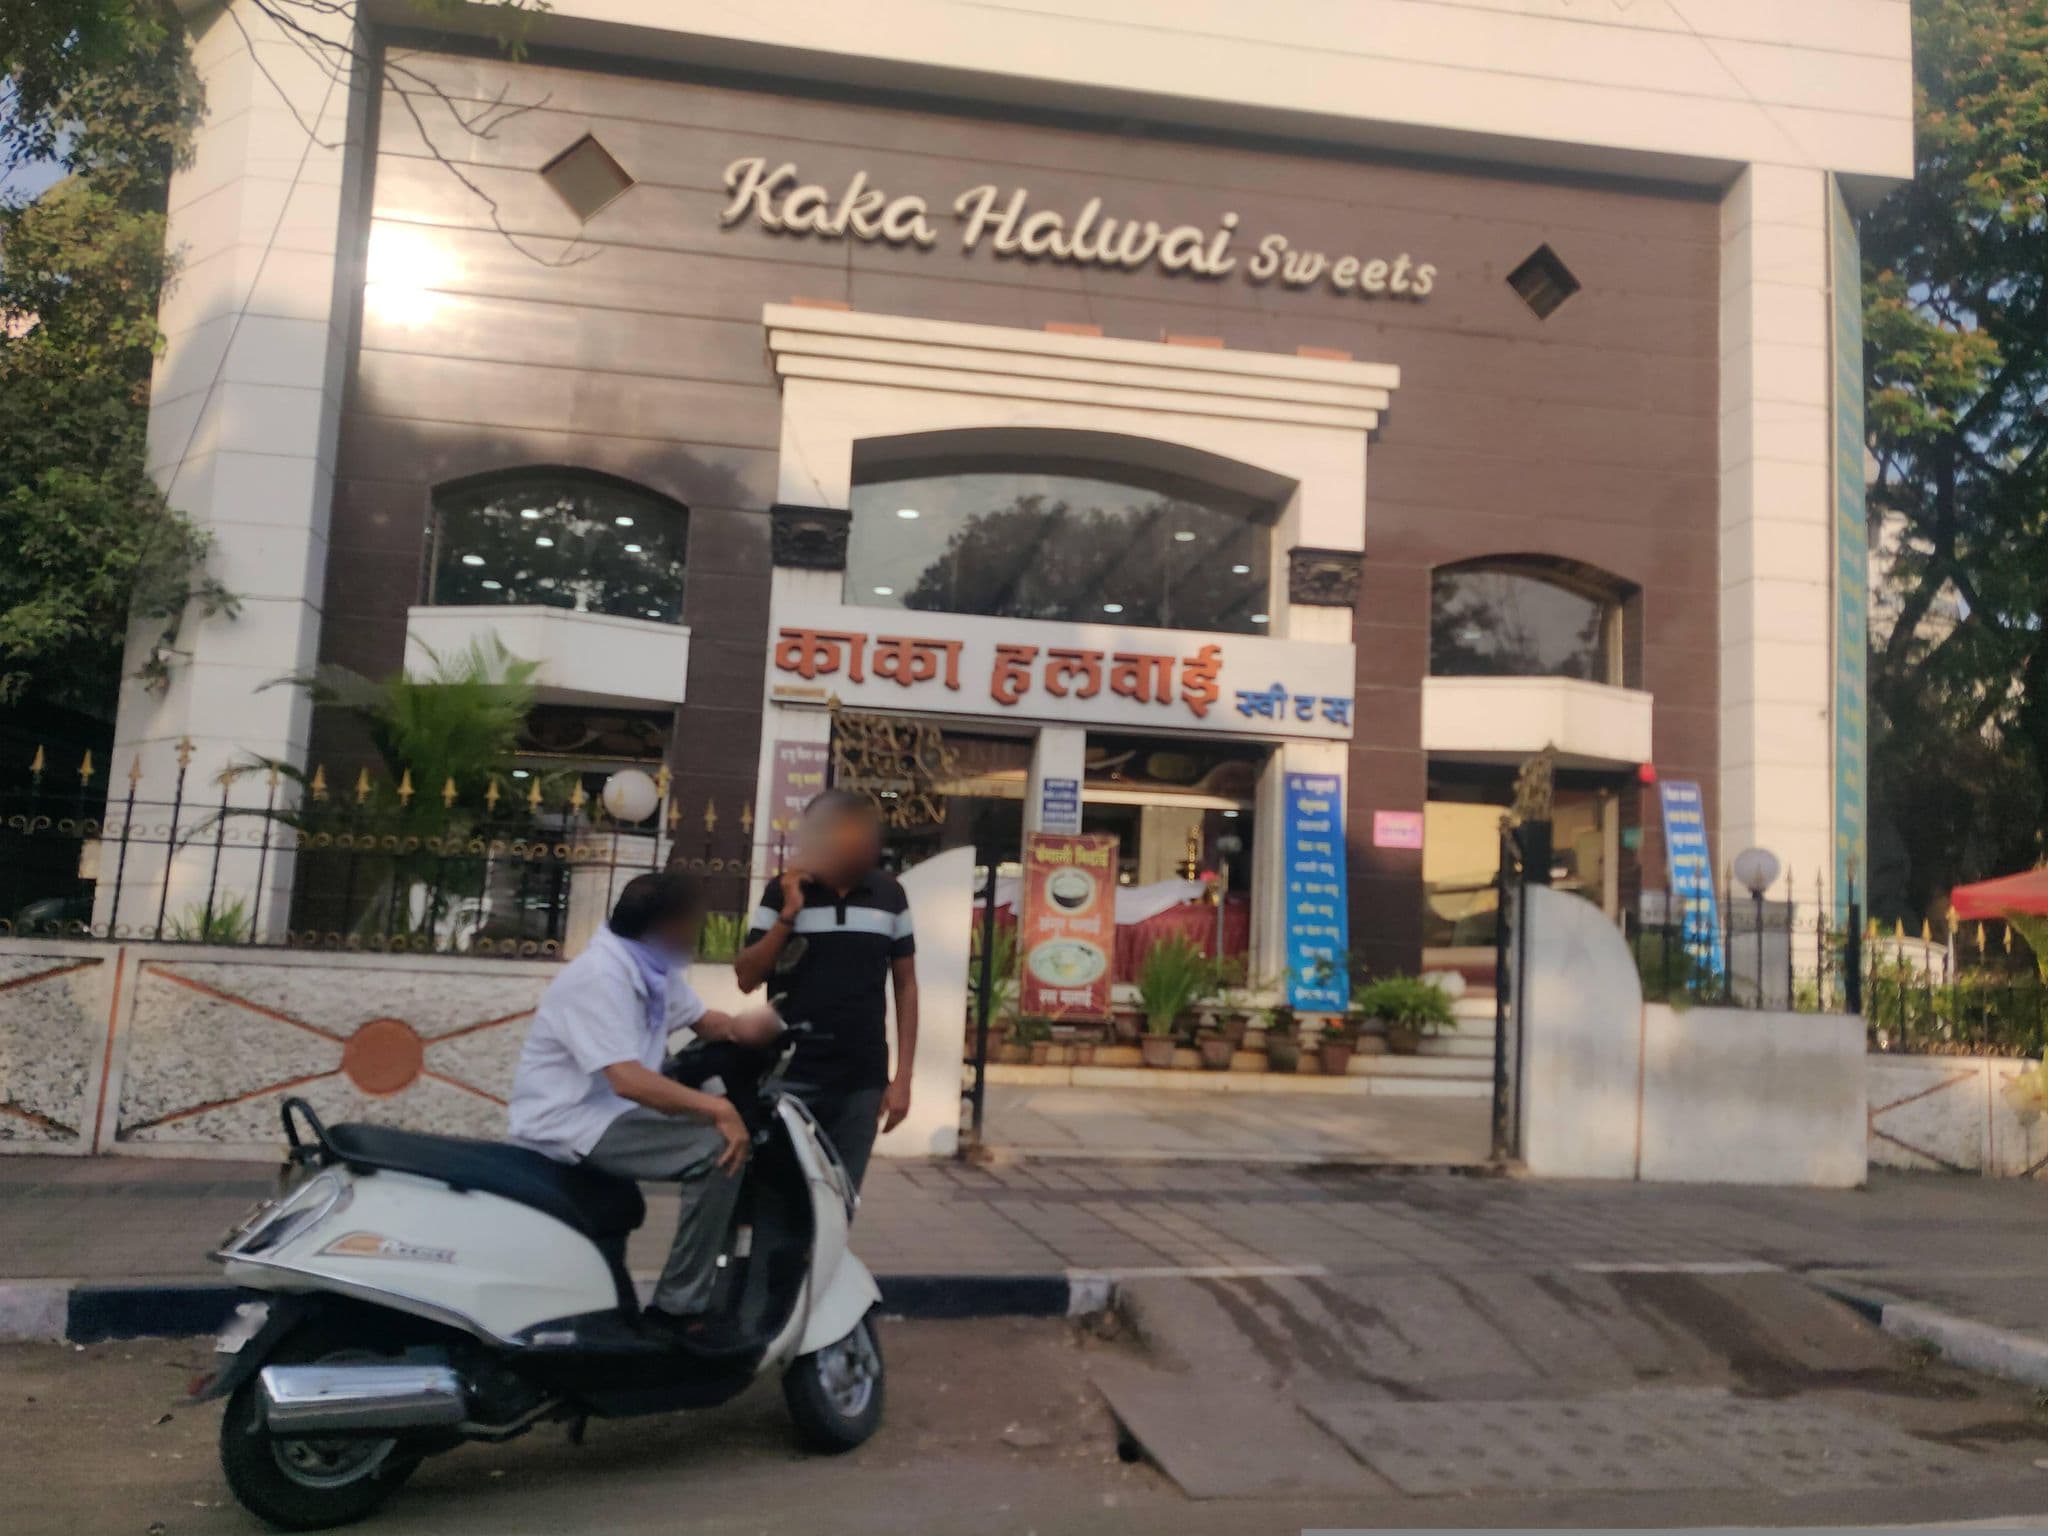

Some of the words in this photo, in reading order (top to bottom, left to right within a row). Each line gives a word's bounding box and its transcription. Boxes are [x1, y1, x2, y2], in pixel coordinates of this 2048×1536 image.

[720, 157, 938, 246] Kaka
[953, 185, 1237, 275] Halwai
[1249, 233, 1438, 296] Sweets
[775, 627, 965, 692] काका
[991, 643, 1223, 719] हलवाई
